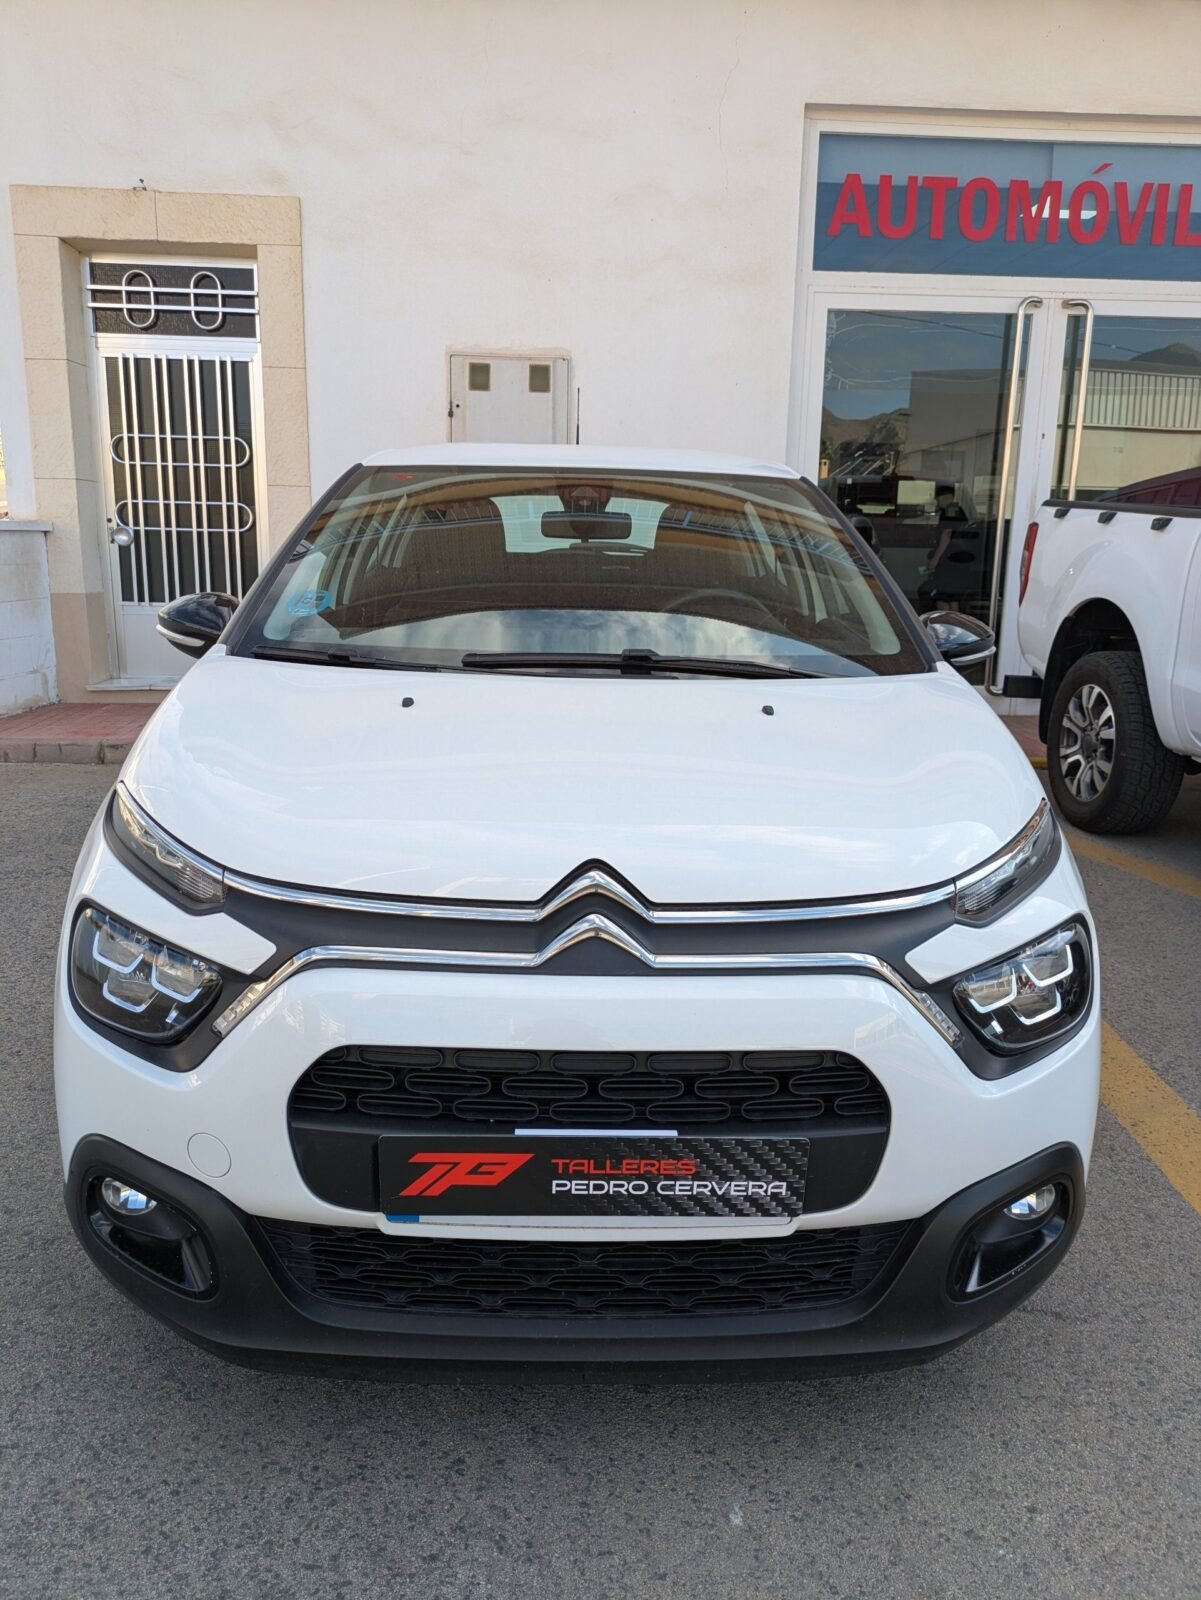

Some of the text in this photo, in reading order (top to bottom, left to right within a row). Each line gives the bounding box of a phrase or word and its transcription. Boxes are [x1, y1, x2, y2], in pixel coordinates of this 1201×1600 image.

[827, 162, 1201, 247] AUTOMÓVIL
[551, 1158, 696, 1175] TALLERES
[551, 1180, 788, 1196] PEDRO CERVERA
